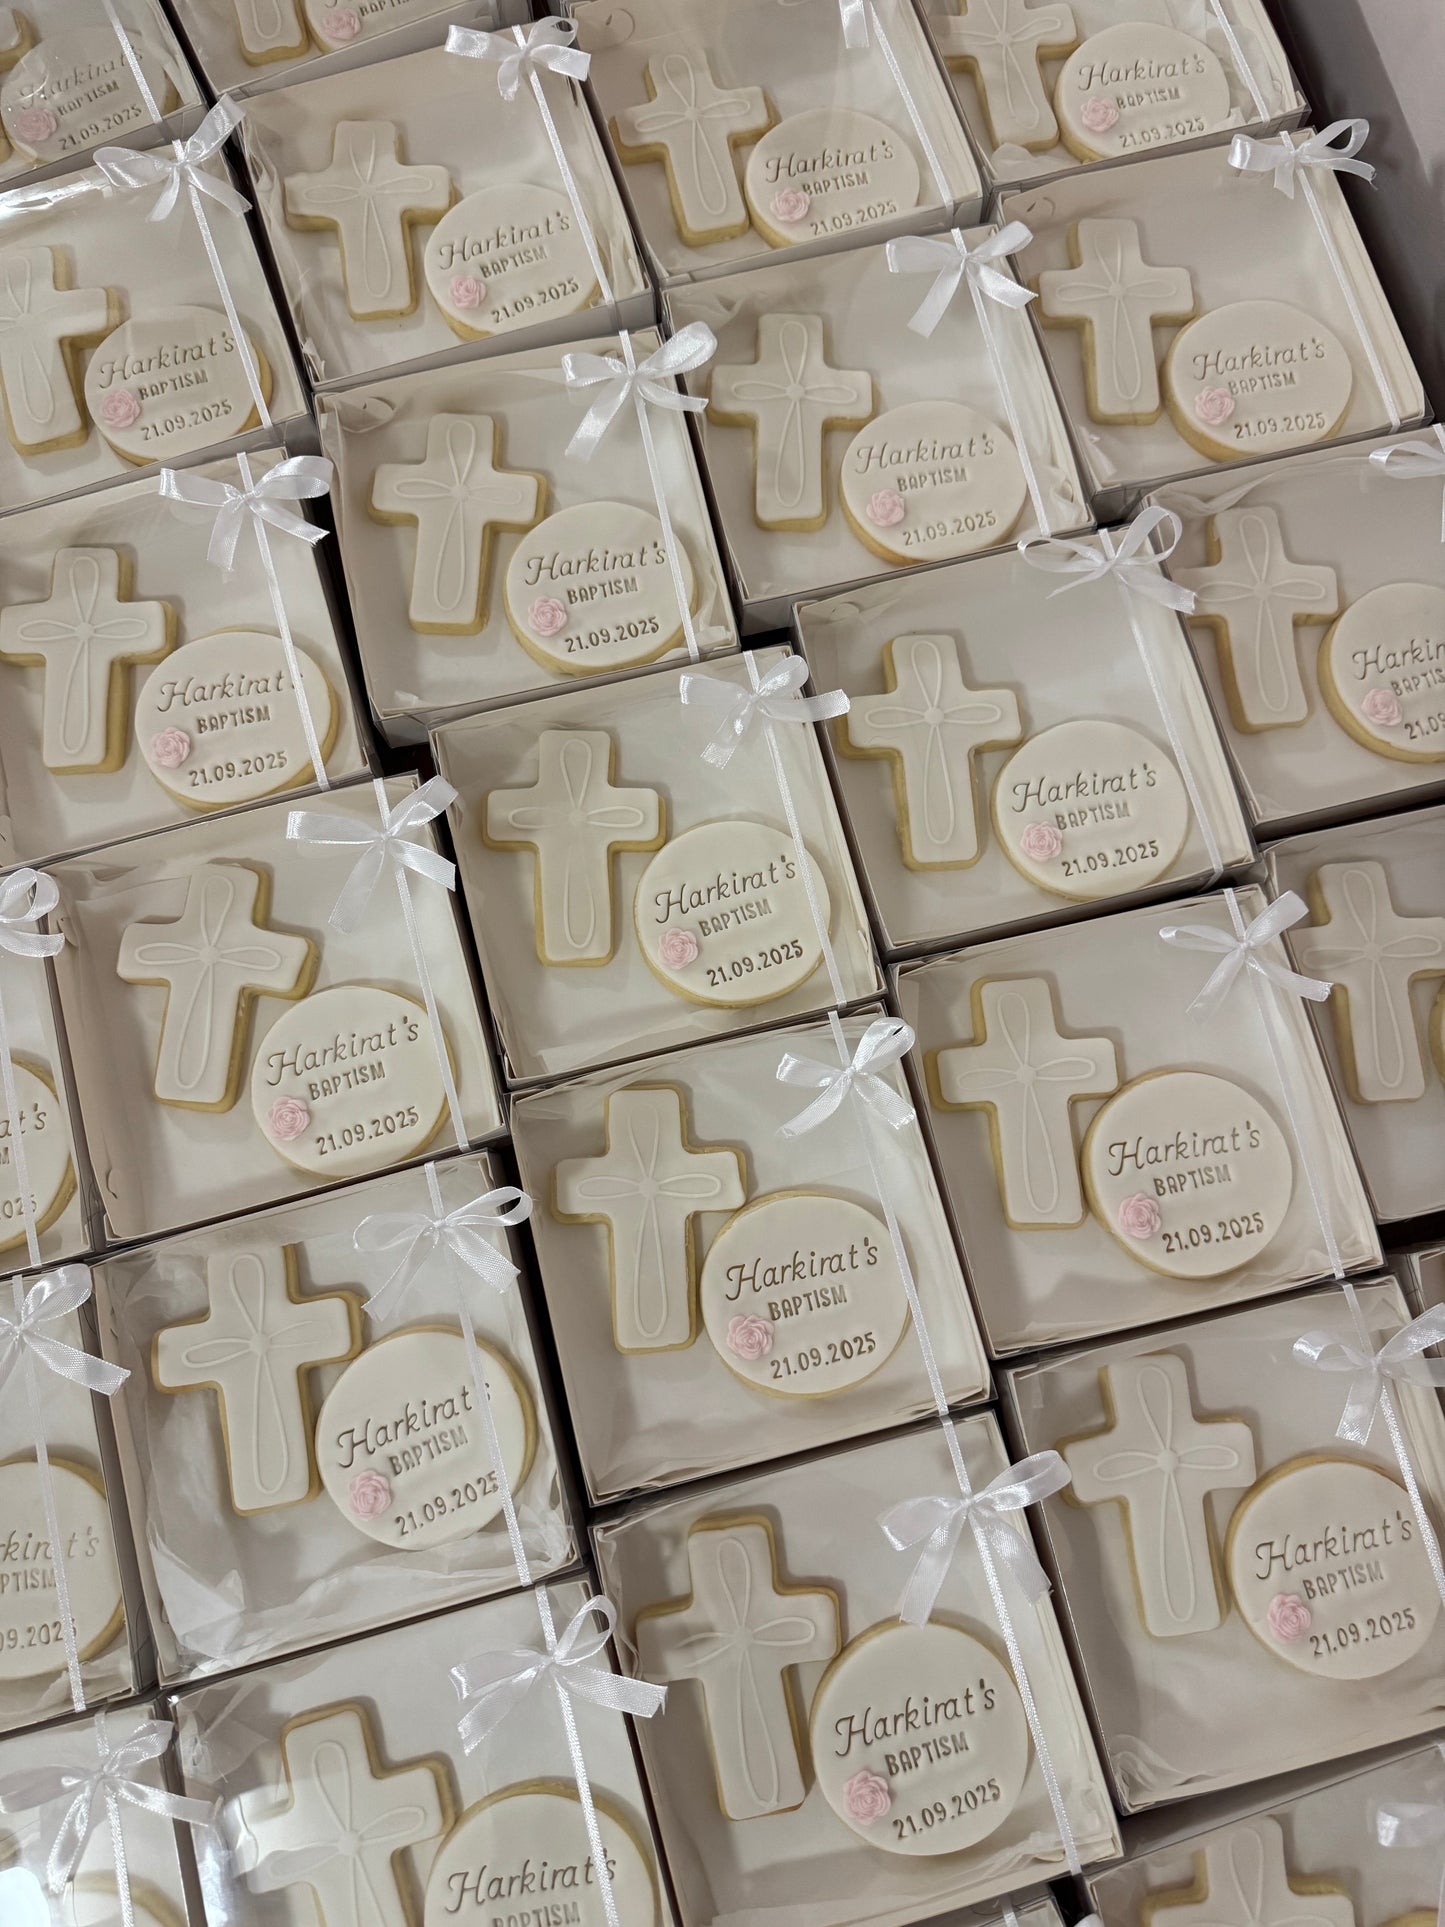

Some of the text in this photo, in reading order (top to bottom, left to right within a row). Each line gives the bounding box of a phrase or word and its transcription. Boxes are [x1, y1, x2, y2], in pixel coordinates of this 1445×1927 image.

[1078, 53, 1206, 91] Harkirat's
[1115, 87, 1182, 110] BAPTISM
[58, 104, 142, 150] 21.09.2025
[1119, 118, 1206, 148] 21.09.2025
[765, 140, 894, 184] Harkirat's
[802, 171, 869, 197] BAPTISM
[810, 201, 897, 236] 21.09.2025
[440, 211, 571, 270] Harkirat's
[480, 245, 548, 279] BAPTISM
[491, 277, 580, 323] 21.09.2025
[99, 331, 235, 389] Harkirat's
[1192, 338, 1326, 381] Harkirat's
[138, 369, 209, 401] BAPTISM
[1228, 371, 1297, 396] BAPTISM
[140, 400, 233, 441] 21.09.2025
[1233, 412, 1326, 439] 21.09.2025
[855, 433, 995, 474] Harkirat's
[896, 467, 968, 492] BAPTISM
[902, 510, 997, 546] 21.09.2025
[524, 541, 667, 586] Harkirat's
[566, 576, 639, 605] BAPTISM
[564, 616, 660, 653] 21.09.2025
[157, 669, 303, 713] Harkirat
[196, 704, 271, 734] BAPTISM
[188, 750, 288, 787] 21.09.2025
[1011, 763, 1158, 813] Harkirat's
[1055, 801, 1131, 831] BAPTISM
[1061, 840, 1160, 877] 21.09.2025
[655, 855, 796, 924] Harkirat's
[698, 898, 773, 937] BAPTISM
[706, 939, 804, 987] 21.09.2025
[267, 1015, 419, 1087] Harkirat's
[308, 1060, 386, 1101] BAPTISM
[315, 1106, 420, 1157] 21.09.2025
[1107, 1120, 1261, 1177] Harkirat's
[1153, 1163, 1232, 1197] BAPTISM
[1162, 1211, 1265, 1253] 21.09.2025
[725, 1236, 879, 1301] Harkirat's
[768, 1284, 848, 1321] BAPTISM
[770, 1331, 876, 1379] 21.09.2025
[336, 1382, 491, 1469] Harkirat
[388, 1425, 469, 1477] BAPTISM
[1255, 1510, 1413, 1580] Harkirat's
[1302, 1559, 1384, 1601] BAPTISM
[1308, 1607, 1416, 1658] 21.09.2025
[835, 1678, 996, 1757] Harkirat's
[884, 1731, 970, 1777] BAPTISM
[892, 1777, 1001, 1840] 21.09.2025
